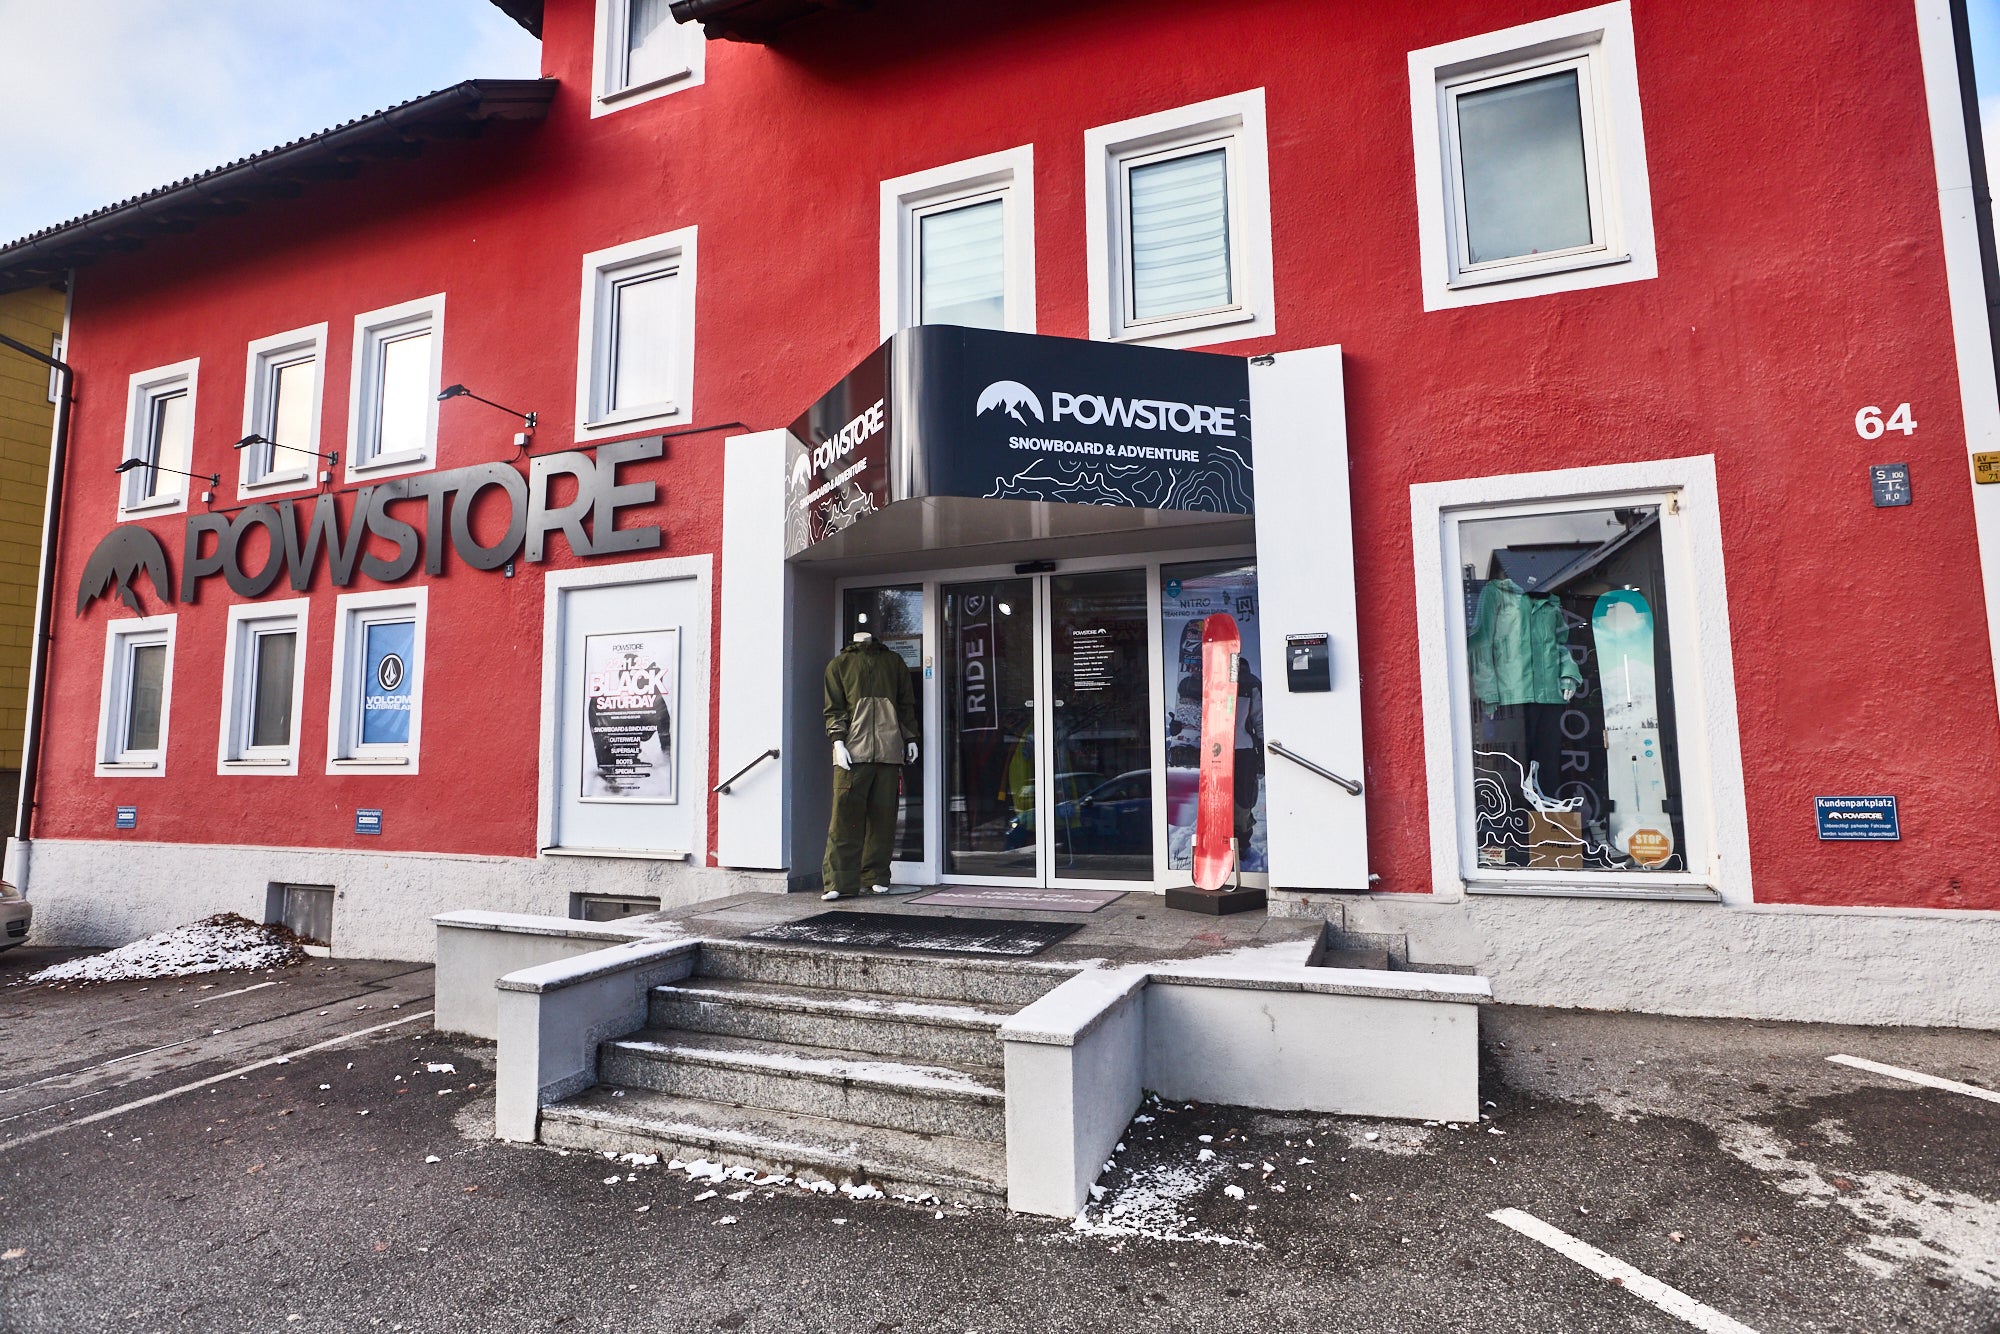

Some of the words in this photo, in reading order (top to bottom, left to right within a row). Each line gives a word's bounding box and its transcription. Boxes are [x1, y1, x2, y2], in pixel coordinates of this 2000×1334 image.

[1052, 391, 1236, 437] POWSTORE
[1855, 402, 1918, 440] 64
[813, 398, 884, 476] POWSTORE
[1009, 436, 1104, 455] SNOWBOARD
[1106, 447, 1116, 456] &
[1117, 446, 1200, 462] ADVENTURE
[800, 482, 830, 510] SNOWBOARD
[834, 457, 867, 487] ADVENTURE
[1876, 470, 1886, 480] S
[179, 435, 664, 603] POWSTORE
[1180, 598, 1211, 609] NITRO
[612, 643, 644, 652] POWSTORE
[588, 668, 669, 698] BLACK
[966, 638, 987, 713] RIDE
[366, 695, 411, 705] VOLCOM
[596, 694, 657, 710] SATURDAY
[1818, 798, 1893, 809] Kundenparkplatz
[1842, 812, 1883, 820] POWSTORE
[1635, 834, 1662, 845] STOP
